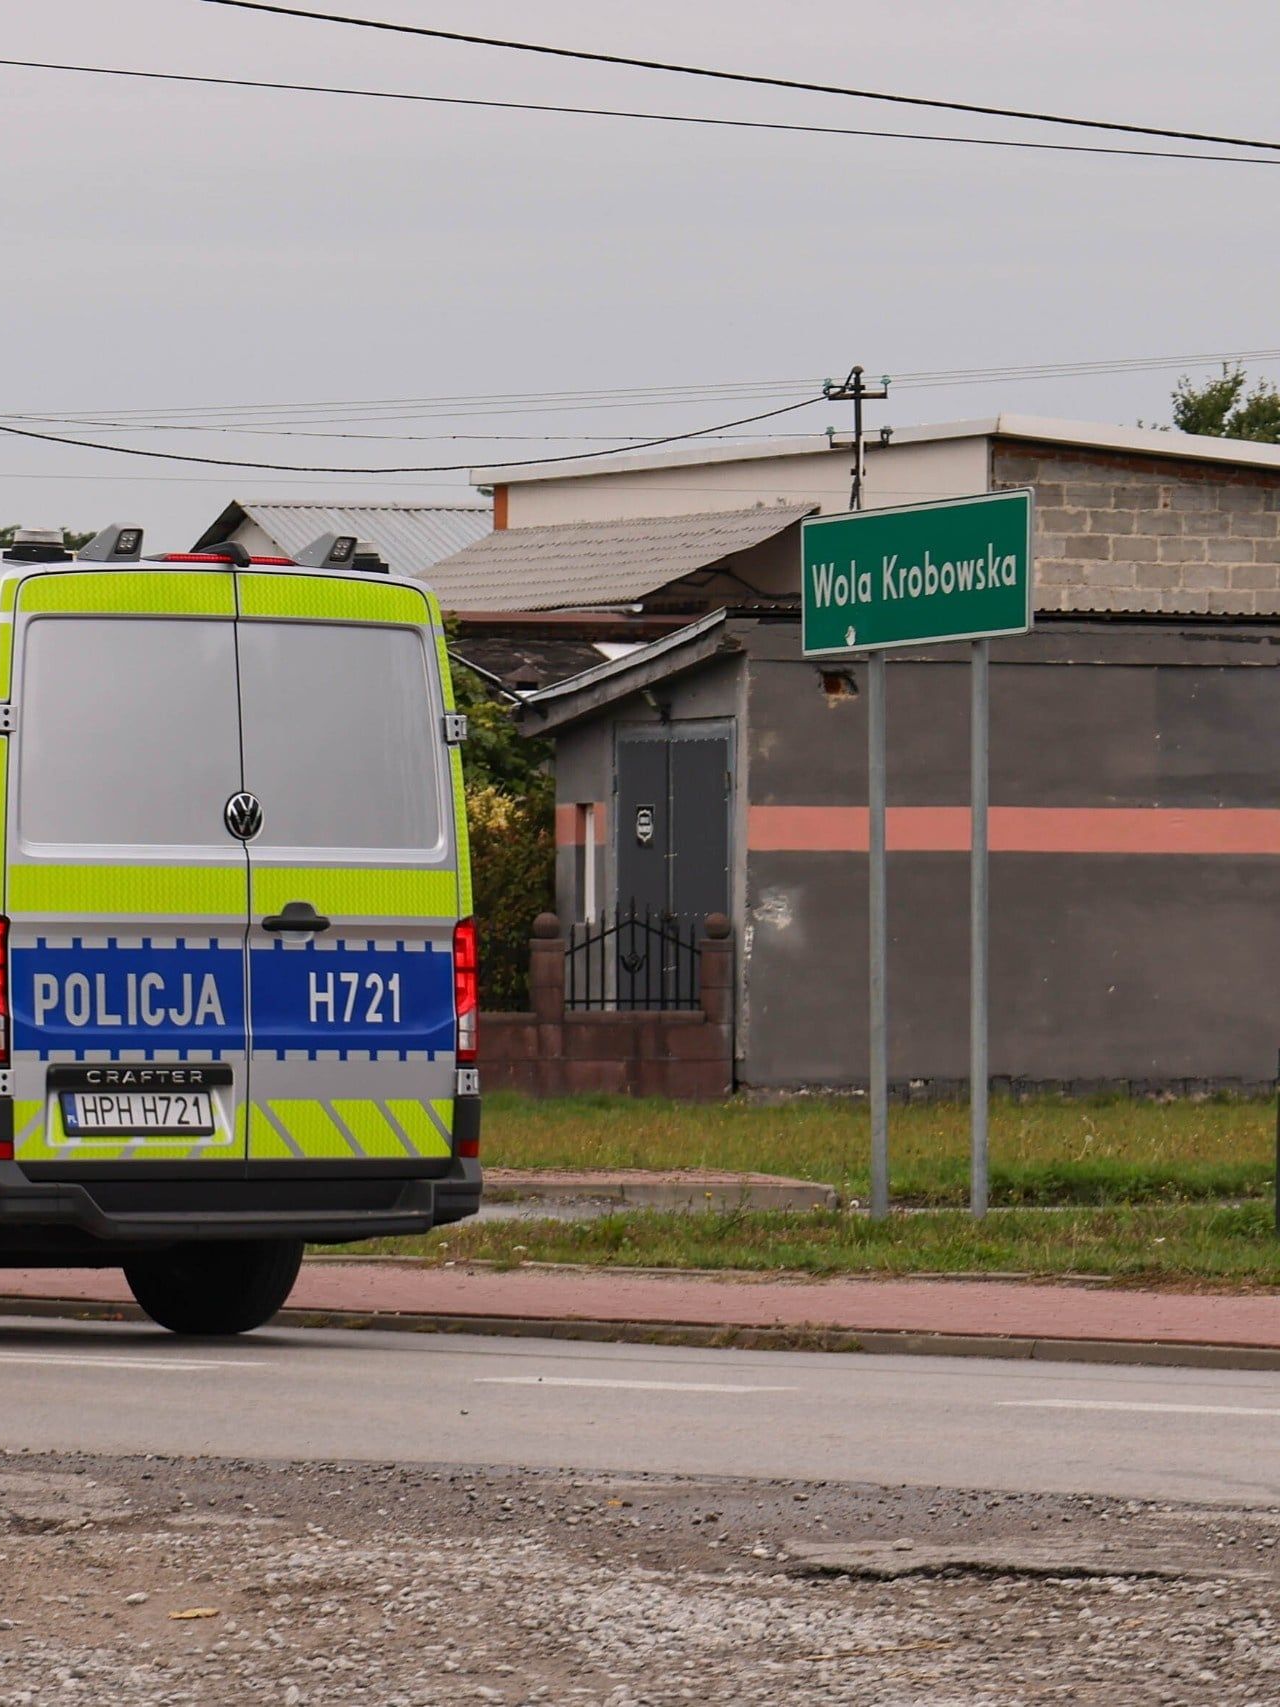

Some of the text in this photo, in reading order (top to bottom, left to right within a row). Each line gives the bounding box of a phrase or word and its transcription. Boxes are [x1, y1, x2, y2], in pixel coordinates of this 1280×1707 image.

[811, 542, 1017, 608] Wola Krobowska
[33, 971, 226, 1027] POLICJA
[308, 971, 401, 1024] H721
[86, 1070, 204, 1084] CRAFTER
[81, 1095, 203, 1126] HPH H721
